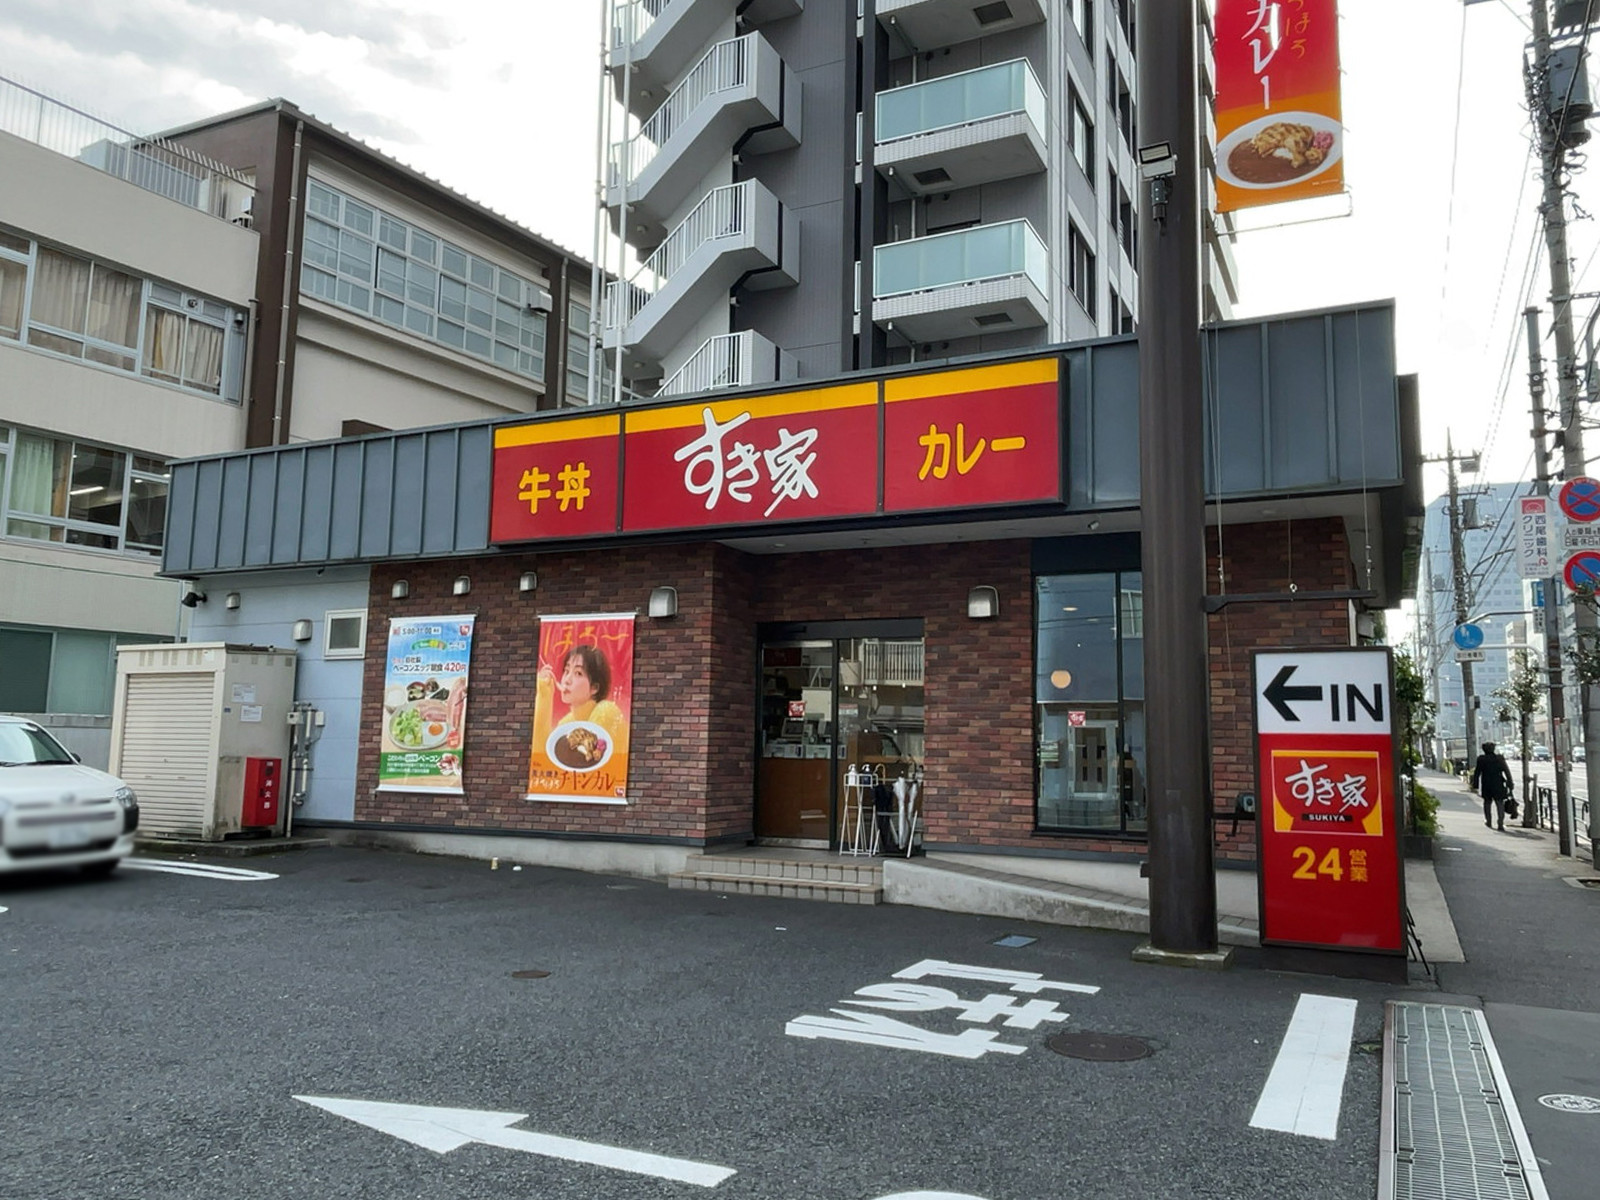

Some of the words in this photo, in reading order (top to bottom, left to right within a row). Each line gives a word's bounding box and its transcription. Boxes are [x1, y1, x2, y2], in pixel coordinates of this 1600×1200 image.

[673, 407, 819, 517] すき家
[918, 423, 1028, 481] カレー
[518, 461, 591, 514] 牛丼
[1522, 515, 1534, 558] クリニック
[1329, 683, 1384, 722] IN
[1285, 759, 1368, 813] すき家
[1308, 814, 1346, 822] SUKIYA
[1292, 846, 1344, 881] 24
[1349, 848, 1368, 883] 営業
